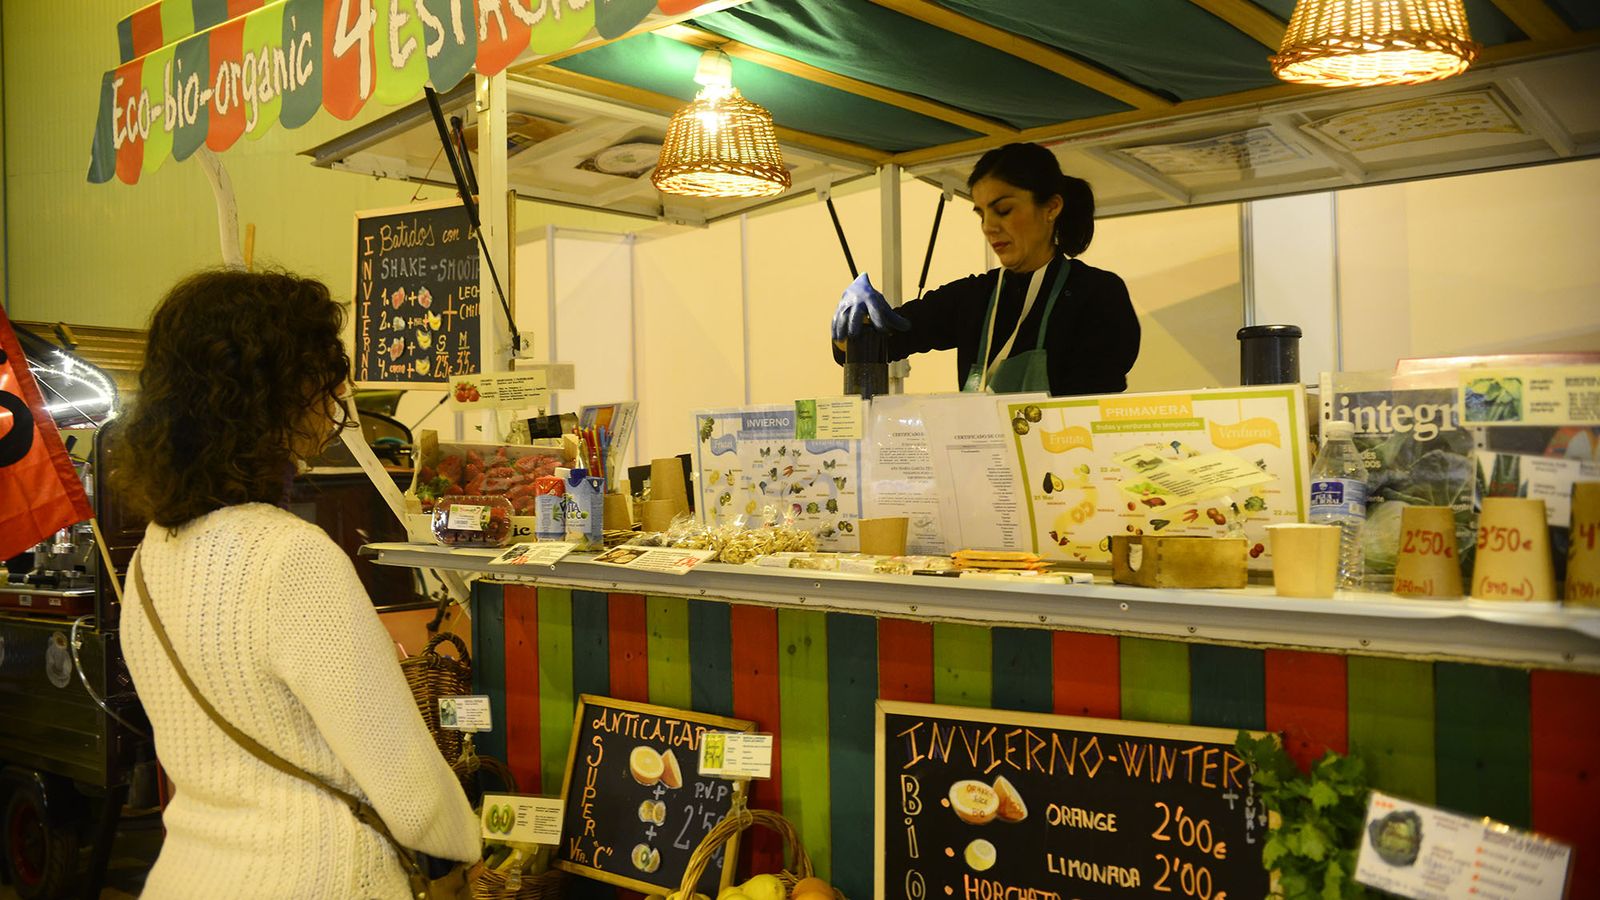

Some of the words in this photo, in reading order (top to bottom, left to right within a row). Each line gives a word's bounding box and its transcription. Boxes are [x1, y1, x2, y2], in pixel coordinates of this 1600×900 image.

[111, 15, 312, 150] Eco-bio-organic
[379, 218, 435, 256] Batidos
[442, 227, 460, 244] con
[381, 256, 426, 280] SHAKE
[361, 236, 374, 381] INVIERNO
[747, 417, 790, 428] INVIERNO
[1105, 404, 1190, 417] PRIMAVERA
[1049, 433, 1085, 445] Frutas
[1403, 529, 1454, 558] 2'50€
[1478, 526, 1533, 552] 3'50€
[592, 708, 718, 751] ANTICATAR
[896, 722, 1246, 788] INVIERNO-WINTER
[581, 735, 604, 838] SUPER
[1046, 803, 1118, 833] ORANGE
[1151, 801, 1227, 860] 2'00€
[1047, 853, 1141, 888] LIMONADA
